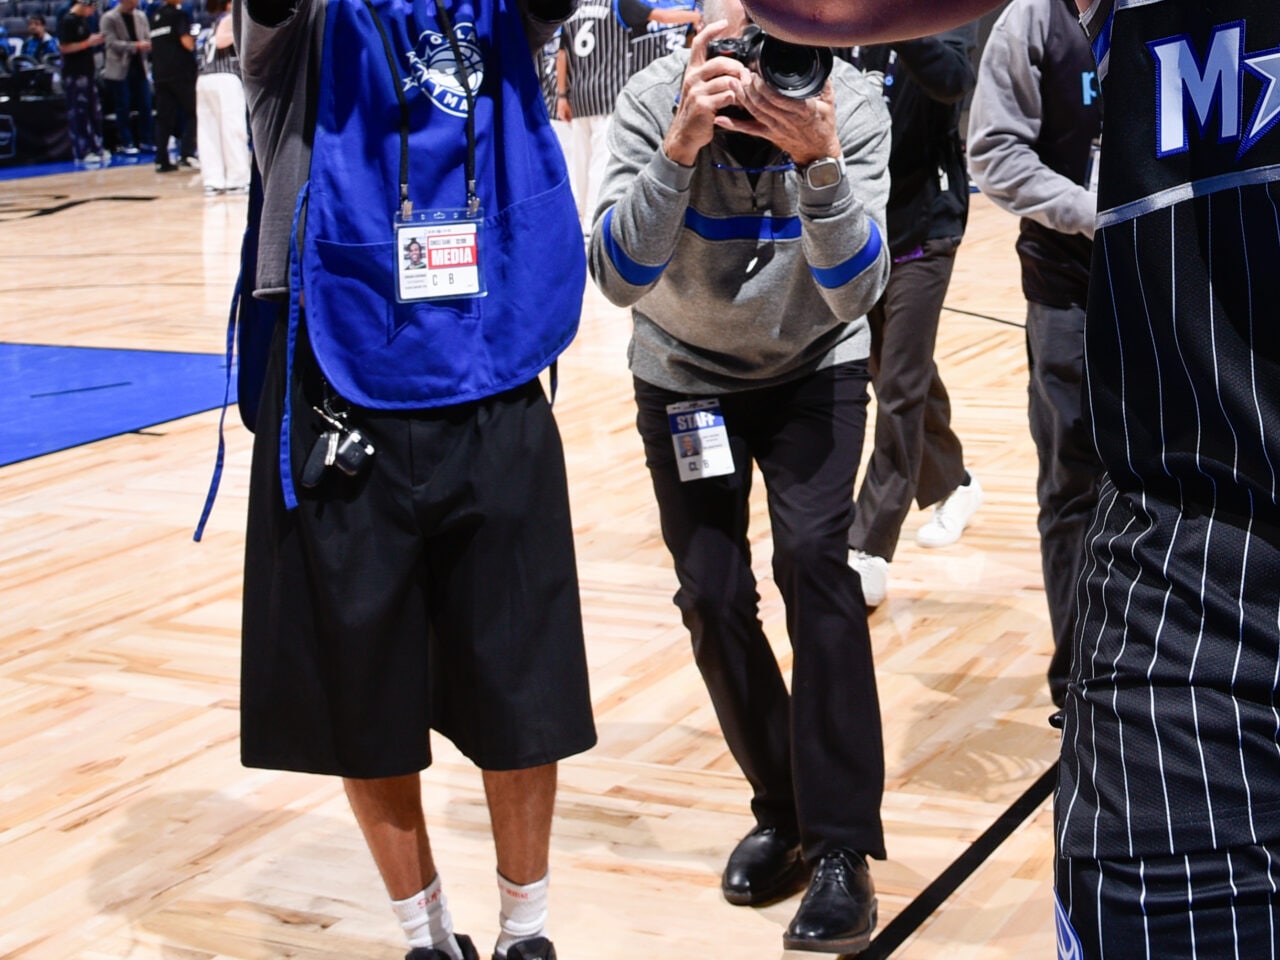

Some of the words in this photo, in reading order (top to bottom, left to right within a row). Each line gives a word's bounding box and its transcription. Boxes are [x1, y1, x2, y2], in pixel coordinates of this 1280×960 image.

[574, 20, 595, 58] 6
[431, 247, 474, 267] MEDIA
[677, 411, 716, 431] STAFF
